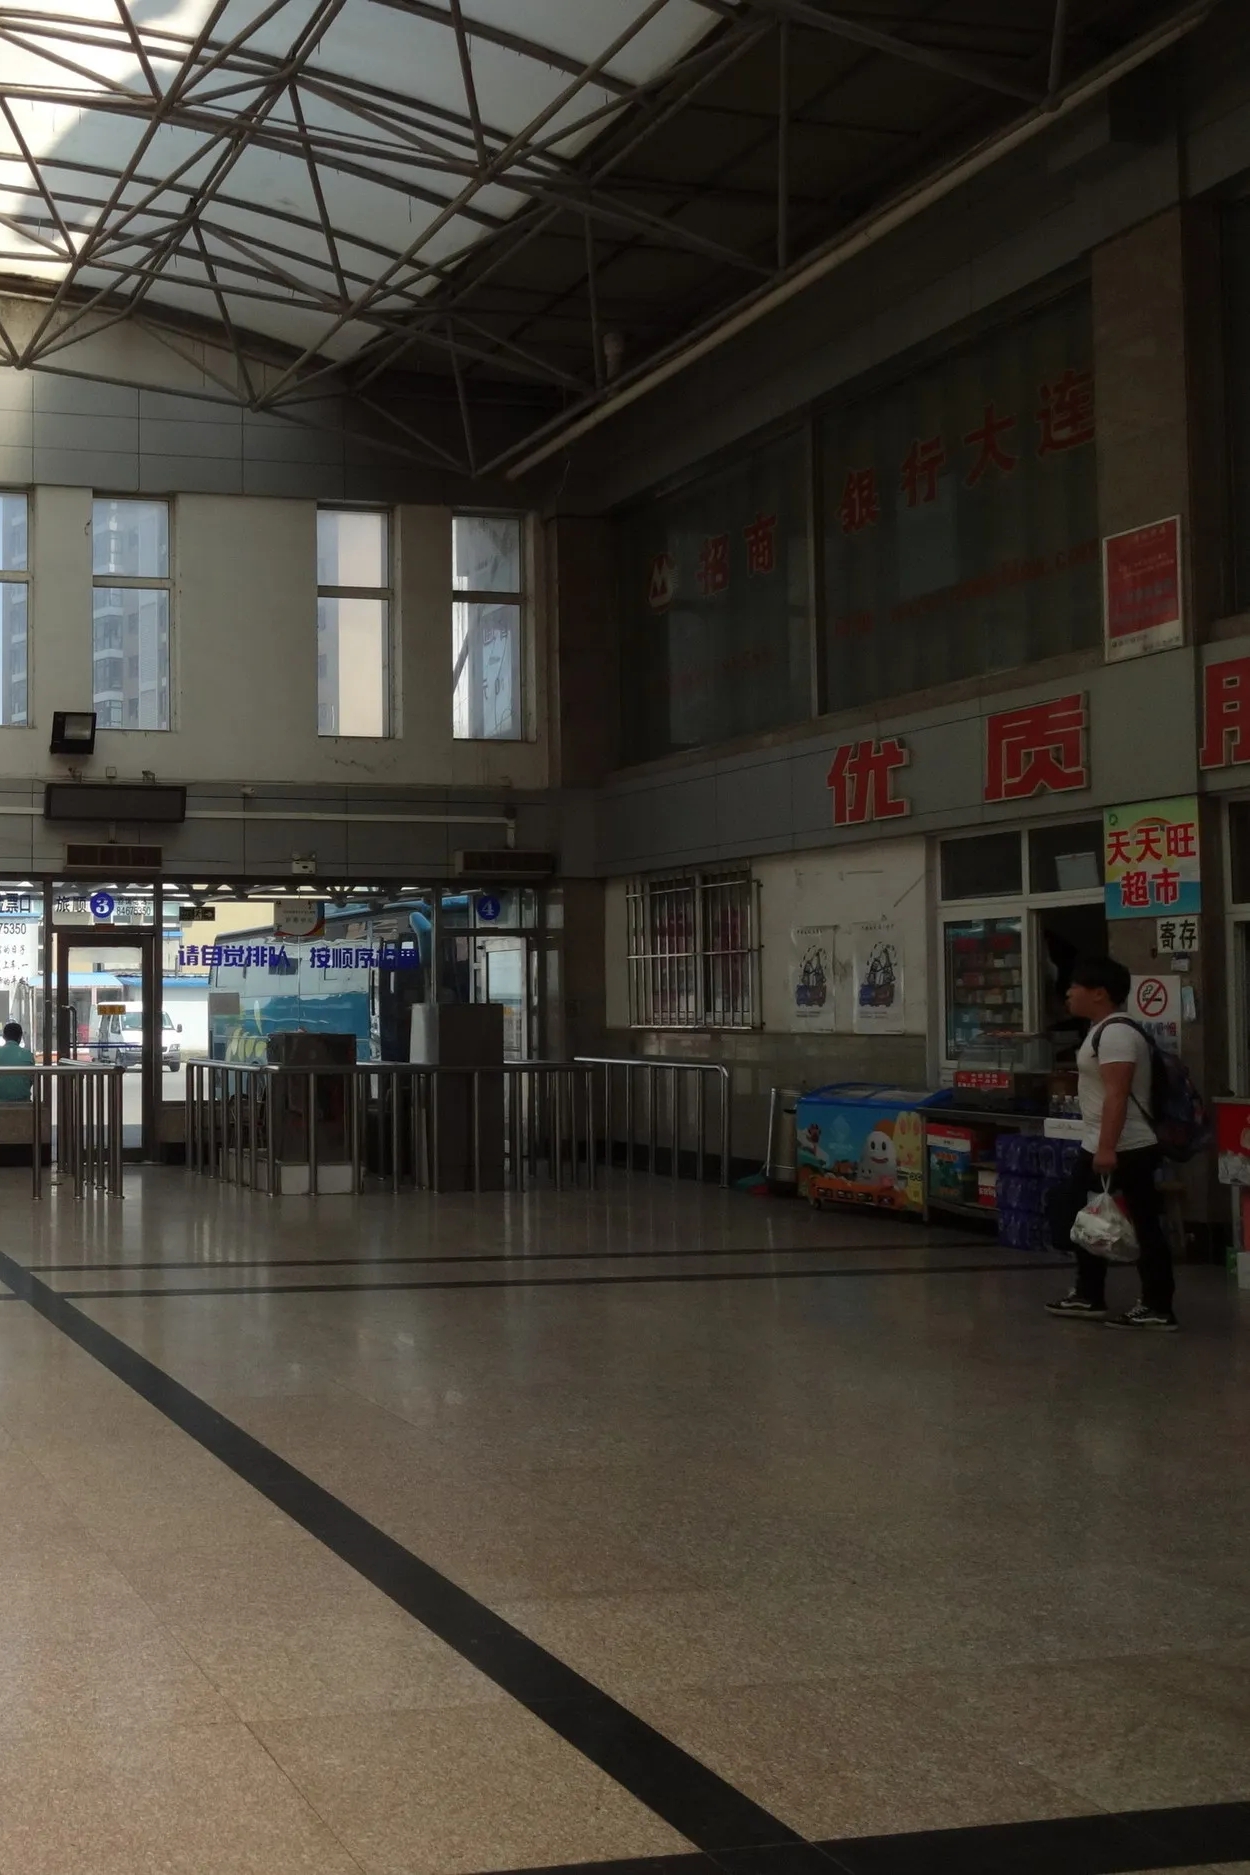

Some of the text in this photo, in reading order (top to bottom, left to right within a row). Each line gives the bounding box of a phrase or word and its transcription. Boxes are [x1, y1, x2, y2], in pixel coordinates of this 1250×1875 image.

[1106, 822, 1197, 867] 天天旺
[1120, 867, 1181, 908] 超市
[56, 895, 88, 913] 旅顺
[117, 906, 152, 916] 84675350
[1159, 919, 1197, 950] 寄存
[178, 945, 291, 968] 请自觉排队
